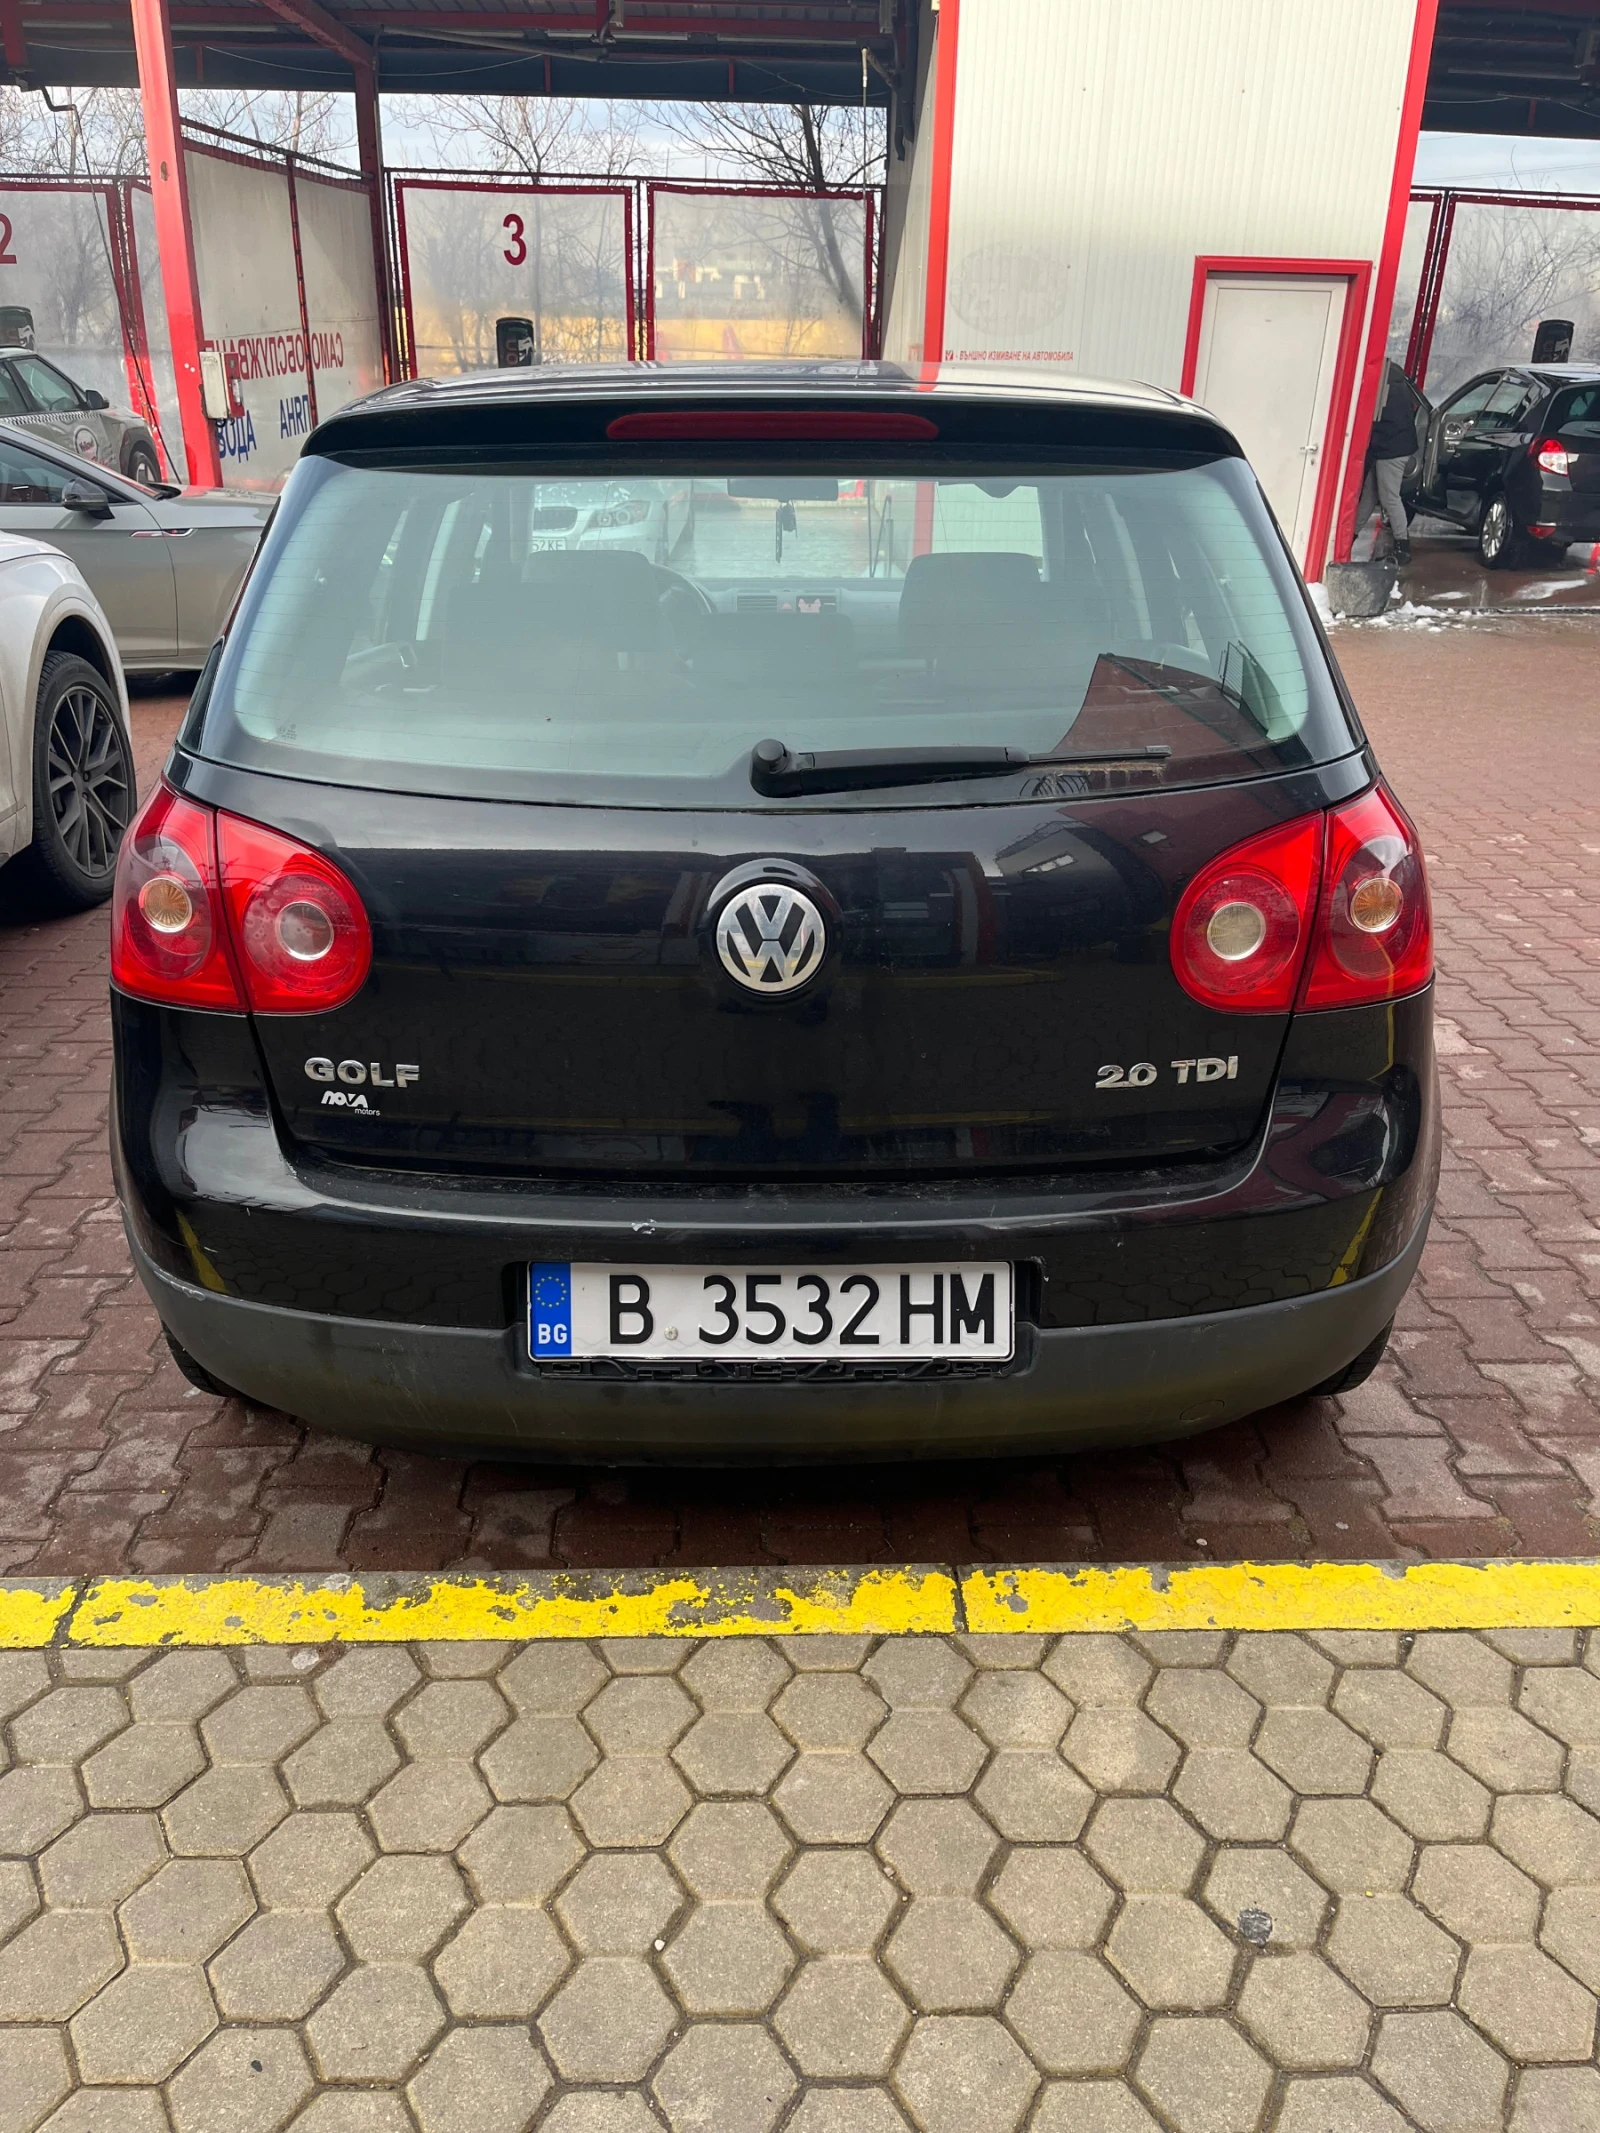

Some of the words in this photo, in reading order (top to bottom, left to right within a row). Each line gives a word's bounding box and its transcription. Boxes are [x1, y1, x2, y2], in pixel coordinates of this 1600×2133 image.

[0, 213, 17, 264] 2
[503, 213, 527, 266] 3
[1022, 351, 1031, 361] НА
[1032, 351, 1074, 361] АВТОМОБИЛА
[304, 1057, 420, 1088] GOLF
[1170, 1055, 1239, 1084] TDI
[354, 1108, 381, 1116] motors
[537, 1323, 568, 1345] BG
